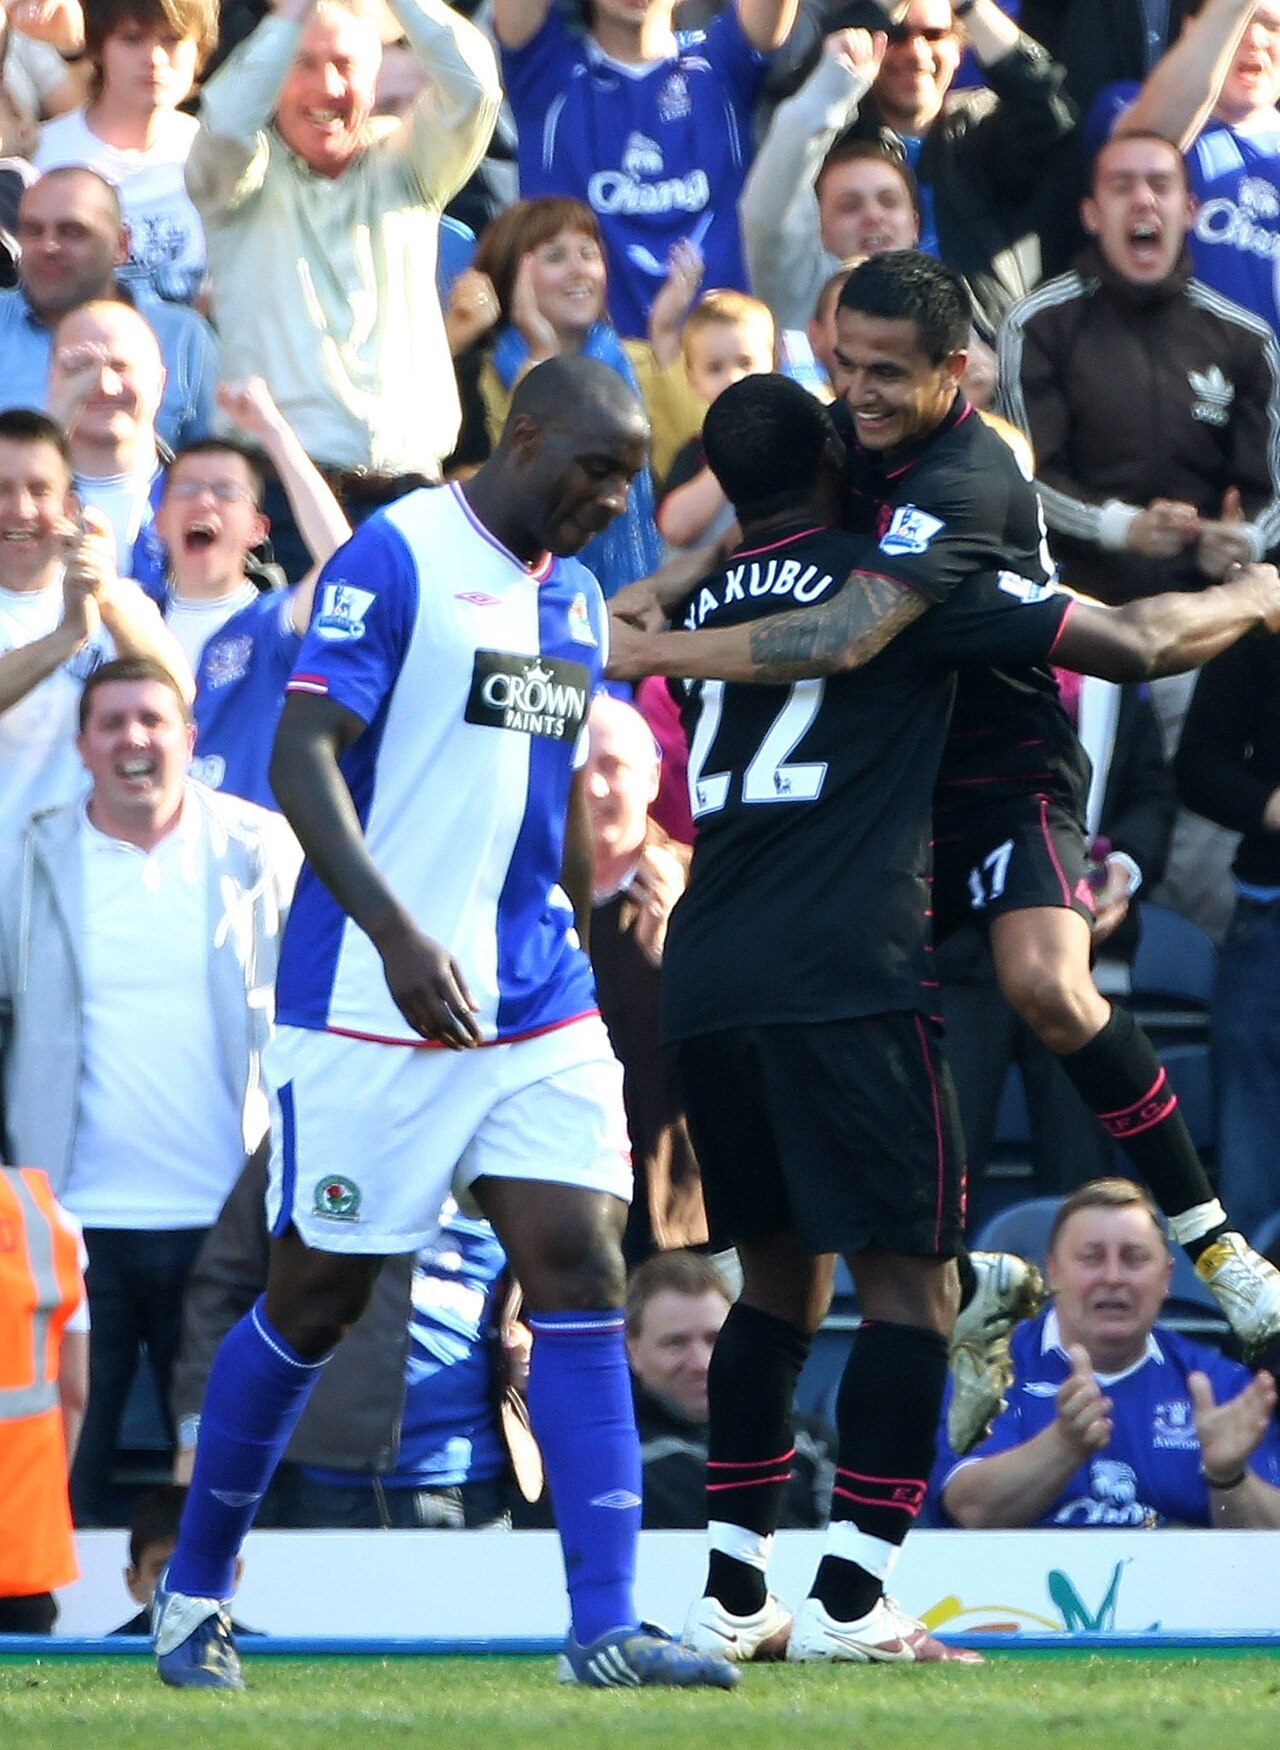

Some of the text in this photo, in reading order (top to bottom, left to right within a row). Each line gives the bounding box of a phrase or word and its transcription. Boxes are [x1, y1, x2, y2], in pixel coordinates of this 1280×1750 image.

[683, 559, 833, 631] YAKUBU
[482, 673, 586, 719] CROWN
[505, 709, 566, 737] PAINTS
[967, 839, 1015, 910] 17
